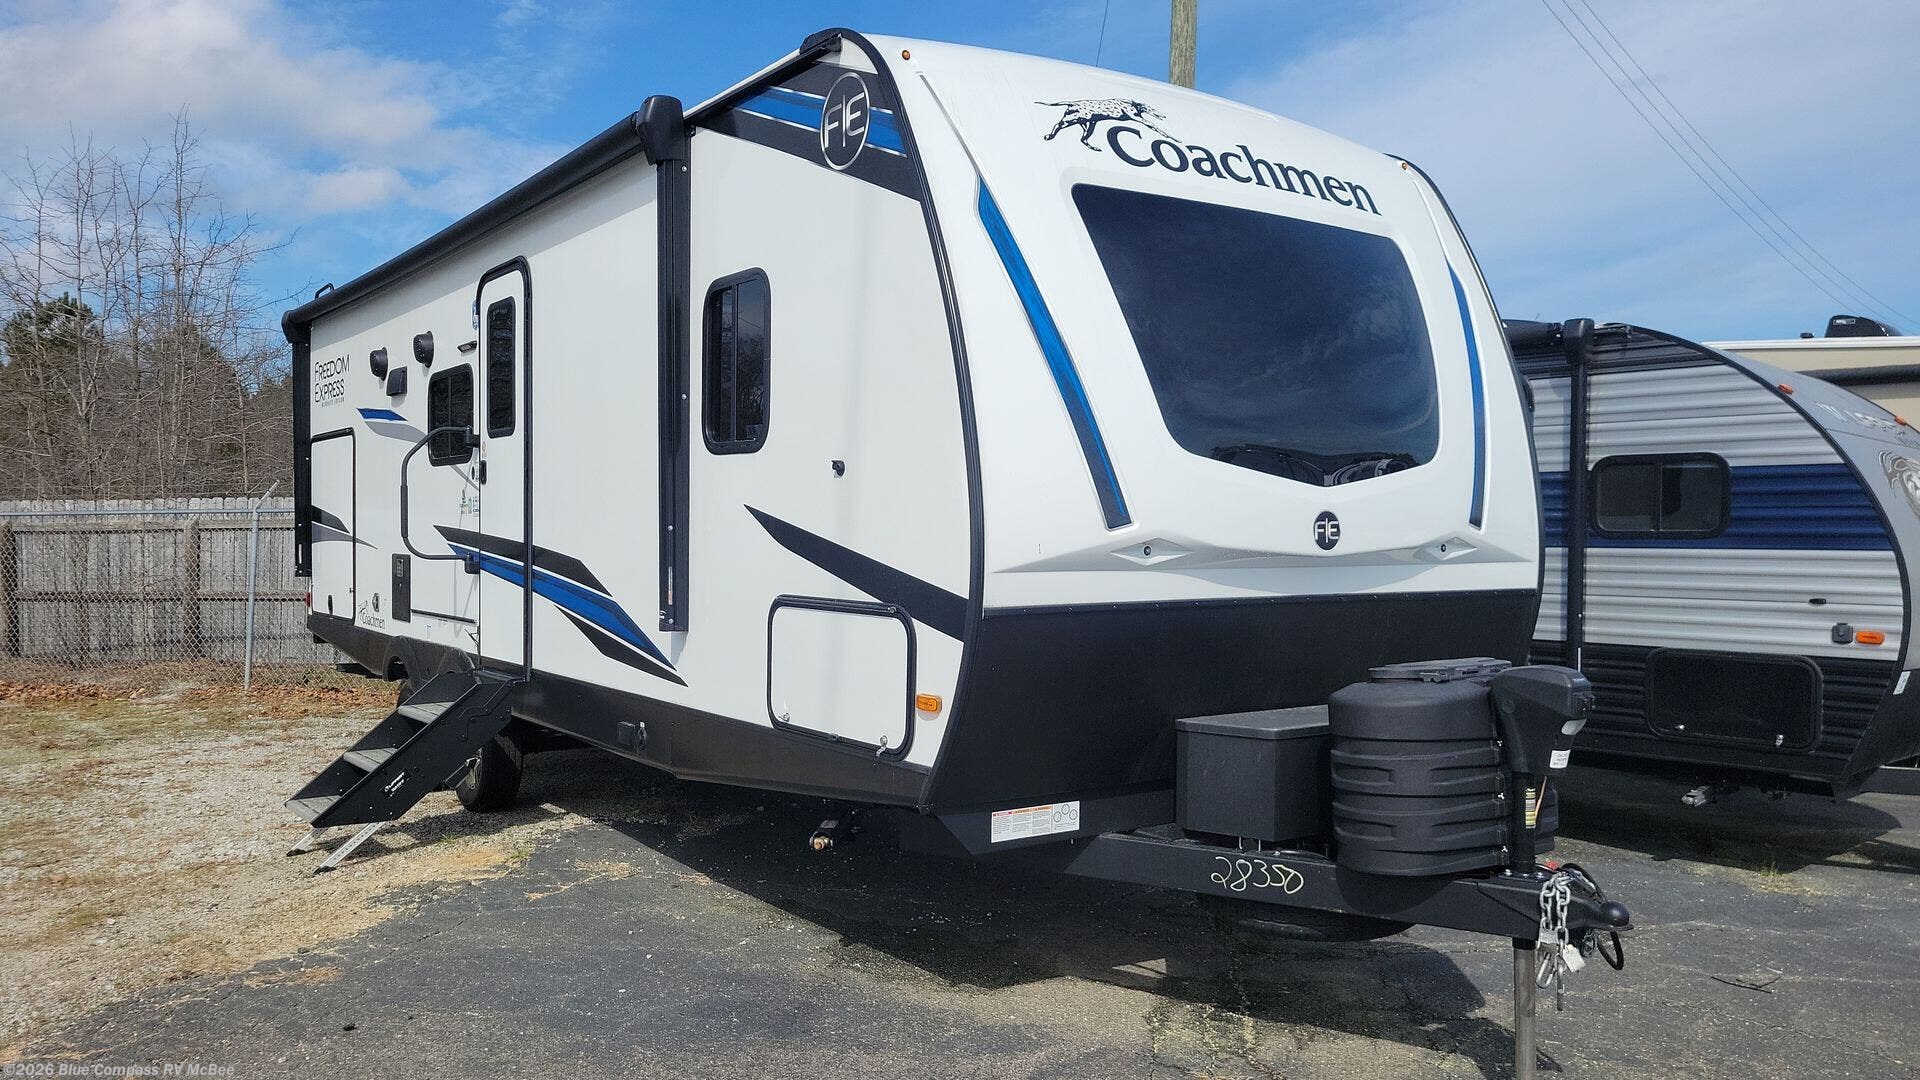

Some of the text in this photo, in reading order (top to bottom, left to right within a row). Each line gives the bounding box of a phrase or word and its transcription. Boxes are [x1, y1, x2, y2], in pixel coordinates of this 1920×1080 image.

[1105, 124, 1383, 217] Coachmen
[314, 353, 350, 382] FREEDOM
[314, 378, 345, 403] EXPRESS
[1210, 856, 1304, 894] 28350
